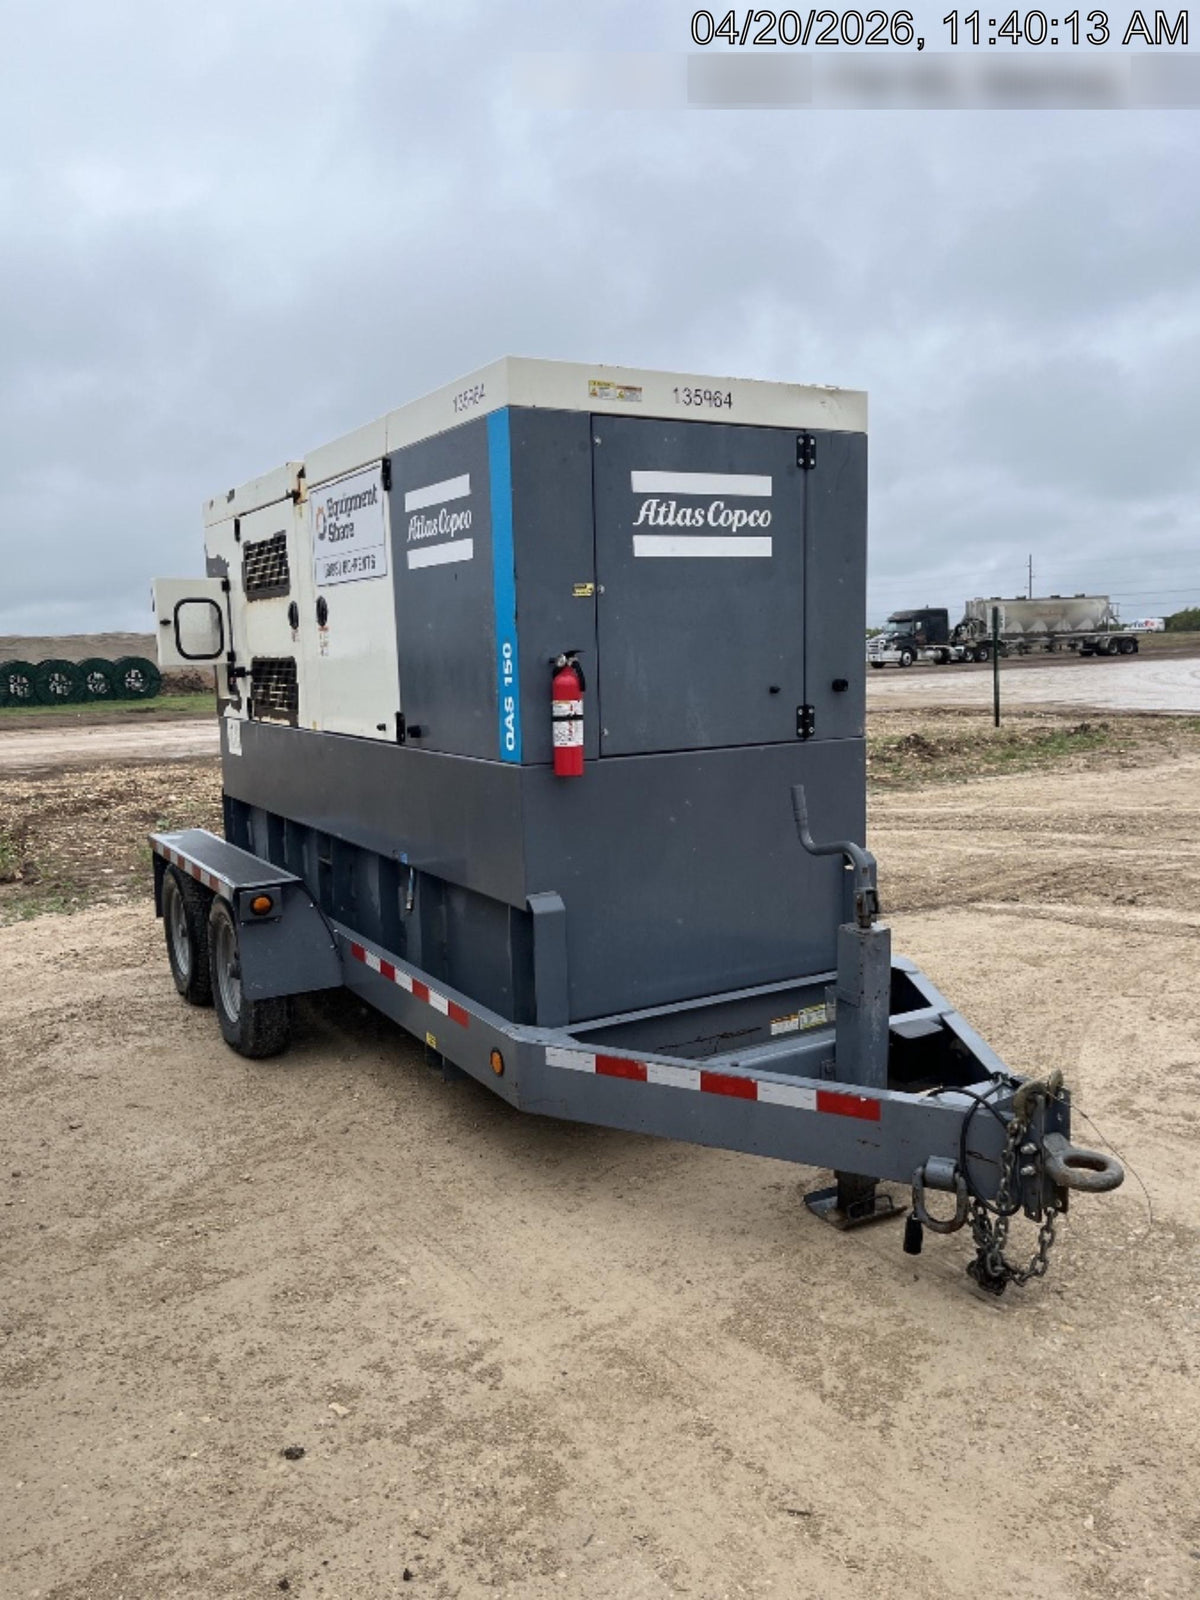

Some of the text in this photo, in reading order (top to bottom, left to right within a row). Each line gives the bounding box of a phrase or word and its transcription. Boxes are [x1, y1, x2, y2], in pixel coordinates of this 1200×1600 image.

[672, 386, 734, 410] 135964
[326, 484, 378, 520] Equipment
[632, 498, 773, 533] Atlas Copco
[328, 522, 355, 543] Share
[407, 507, 472, 543] Atlas Copco
[503, 643, 513, 686] 150
